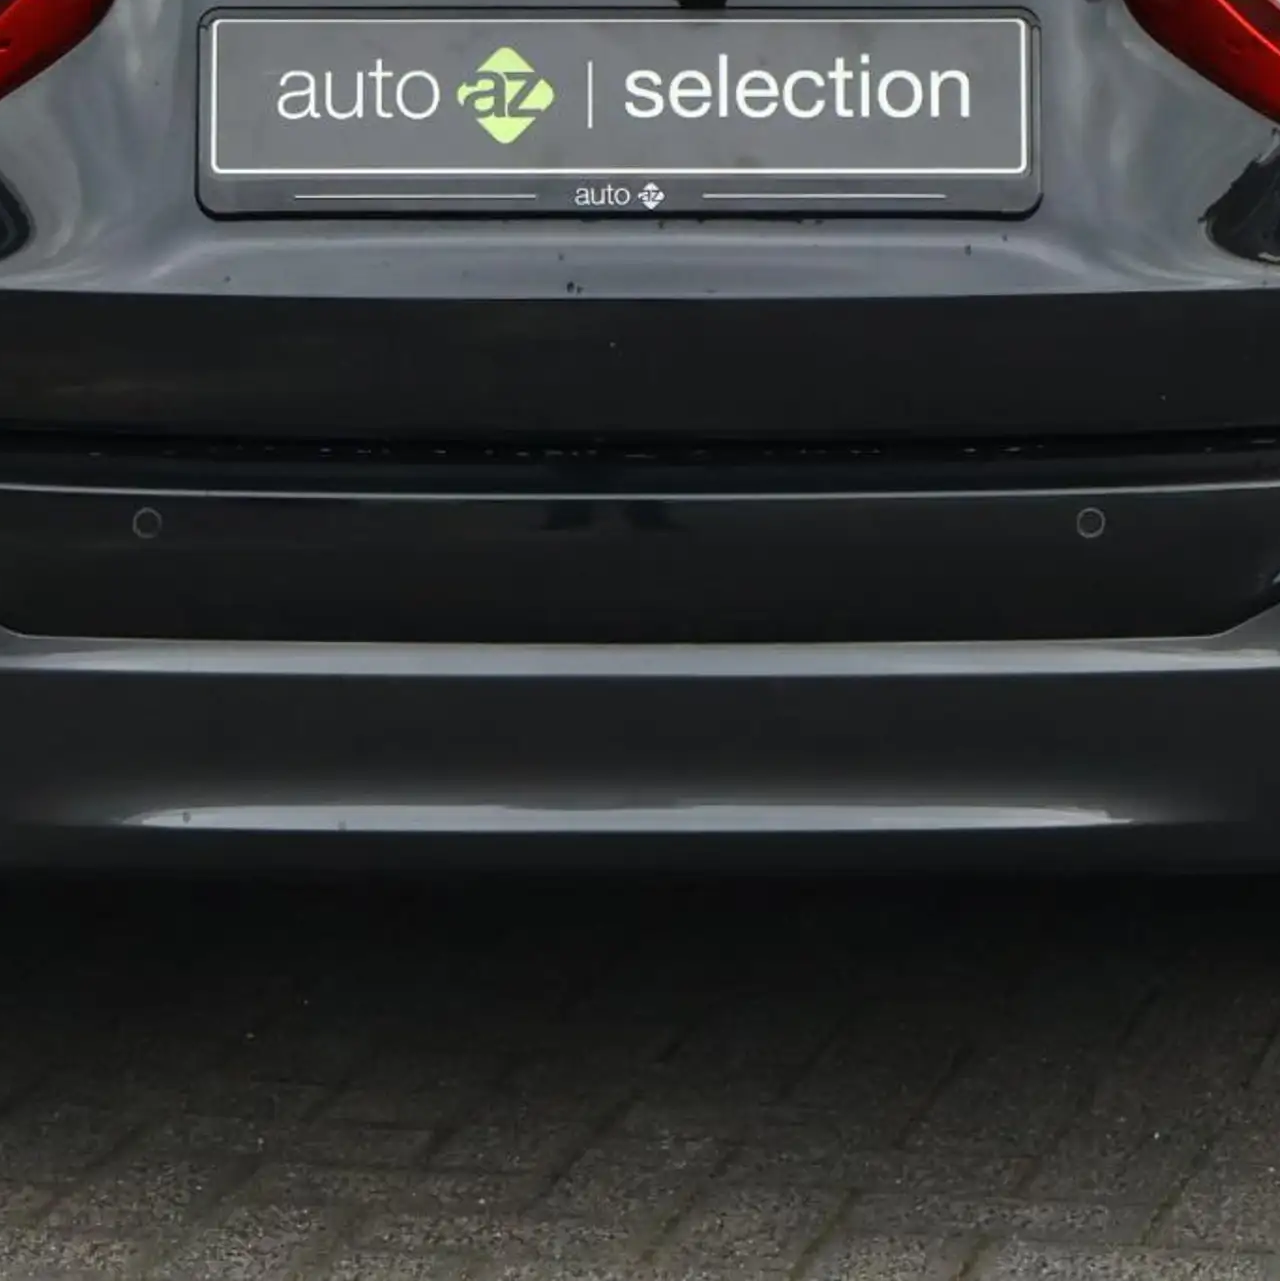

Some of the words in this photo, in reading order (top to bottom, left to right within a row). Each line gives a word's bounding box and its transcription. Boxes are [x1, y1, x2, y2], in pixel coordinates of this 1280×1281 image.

[276, 58, 441, 121] auto
[460, 70, 544, 120] az
[624, 53, 971, 119] selection
[573, 183, 631, 206] auto
